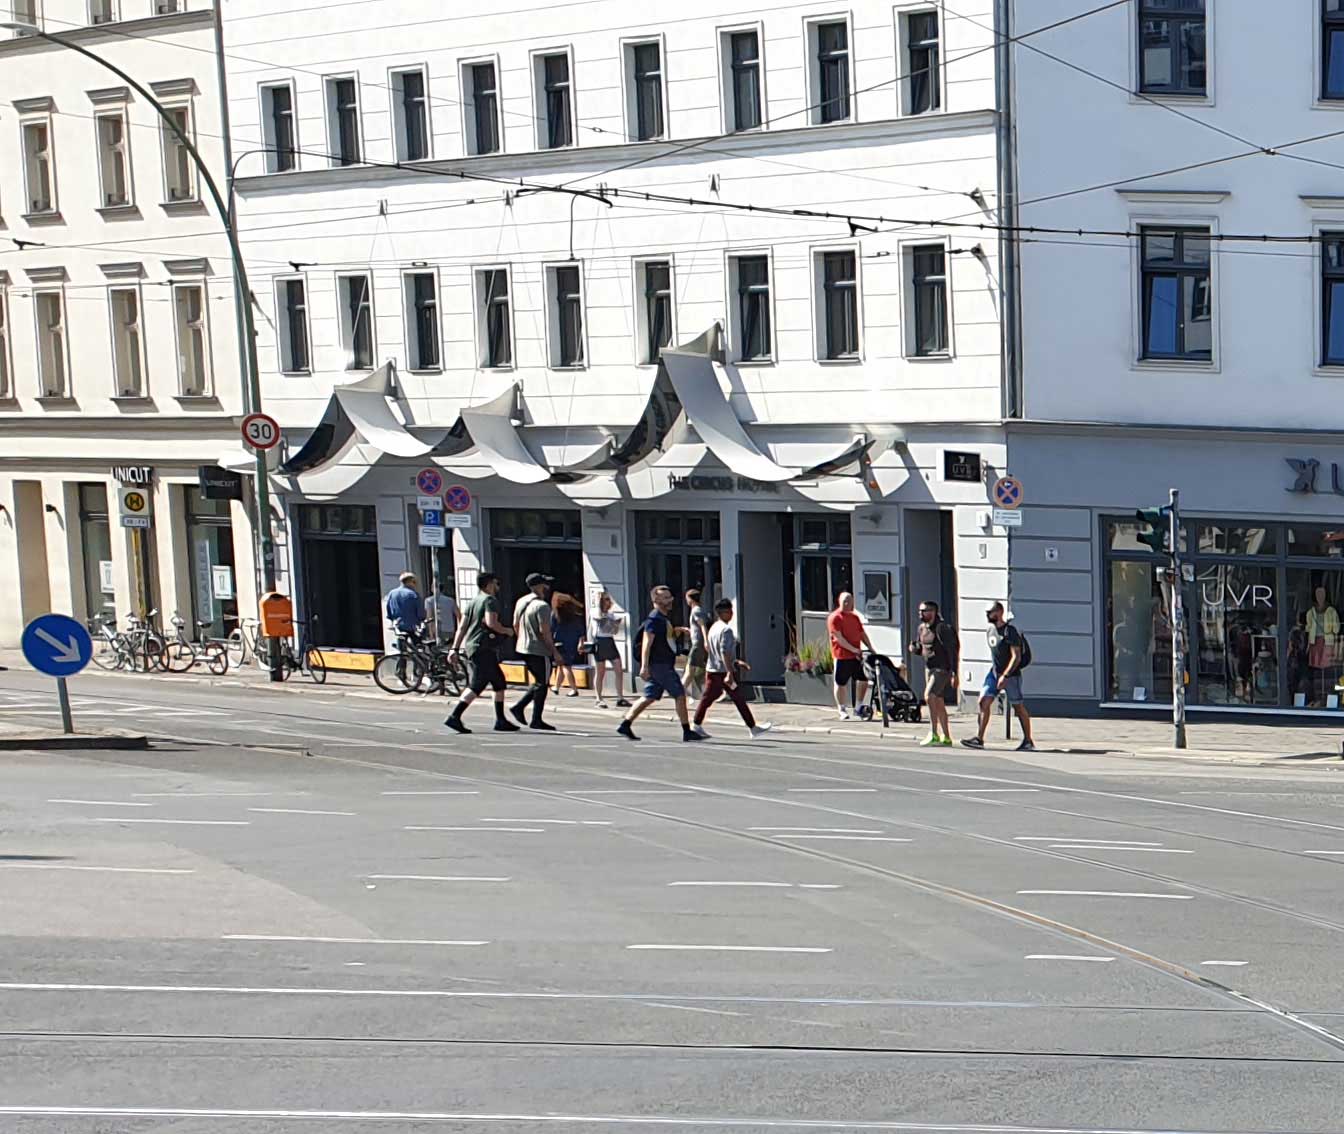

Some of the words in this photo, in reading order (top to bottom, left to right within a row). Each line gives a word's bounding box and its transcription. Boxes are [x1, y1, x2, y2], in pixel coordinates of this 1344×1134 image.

[250, 423, 272, 439] 30
[111, 467, 151, 483] UNICUT
[1202, 583, 1273, 607] UVR
